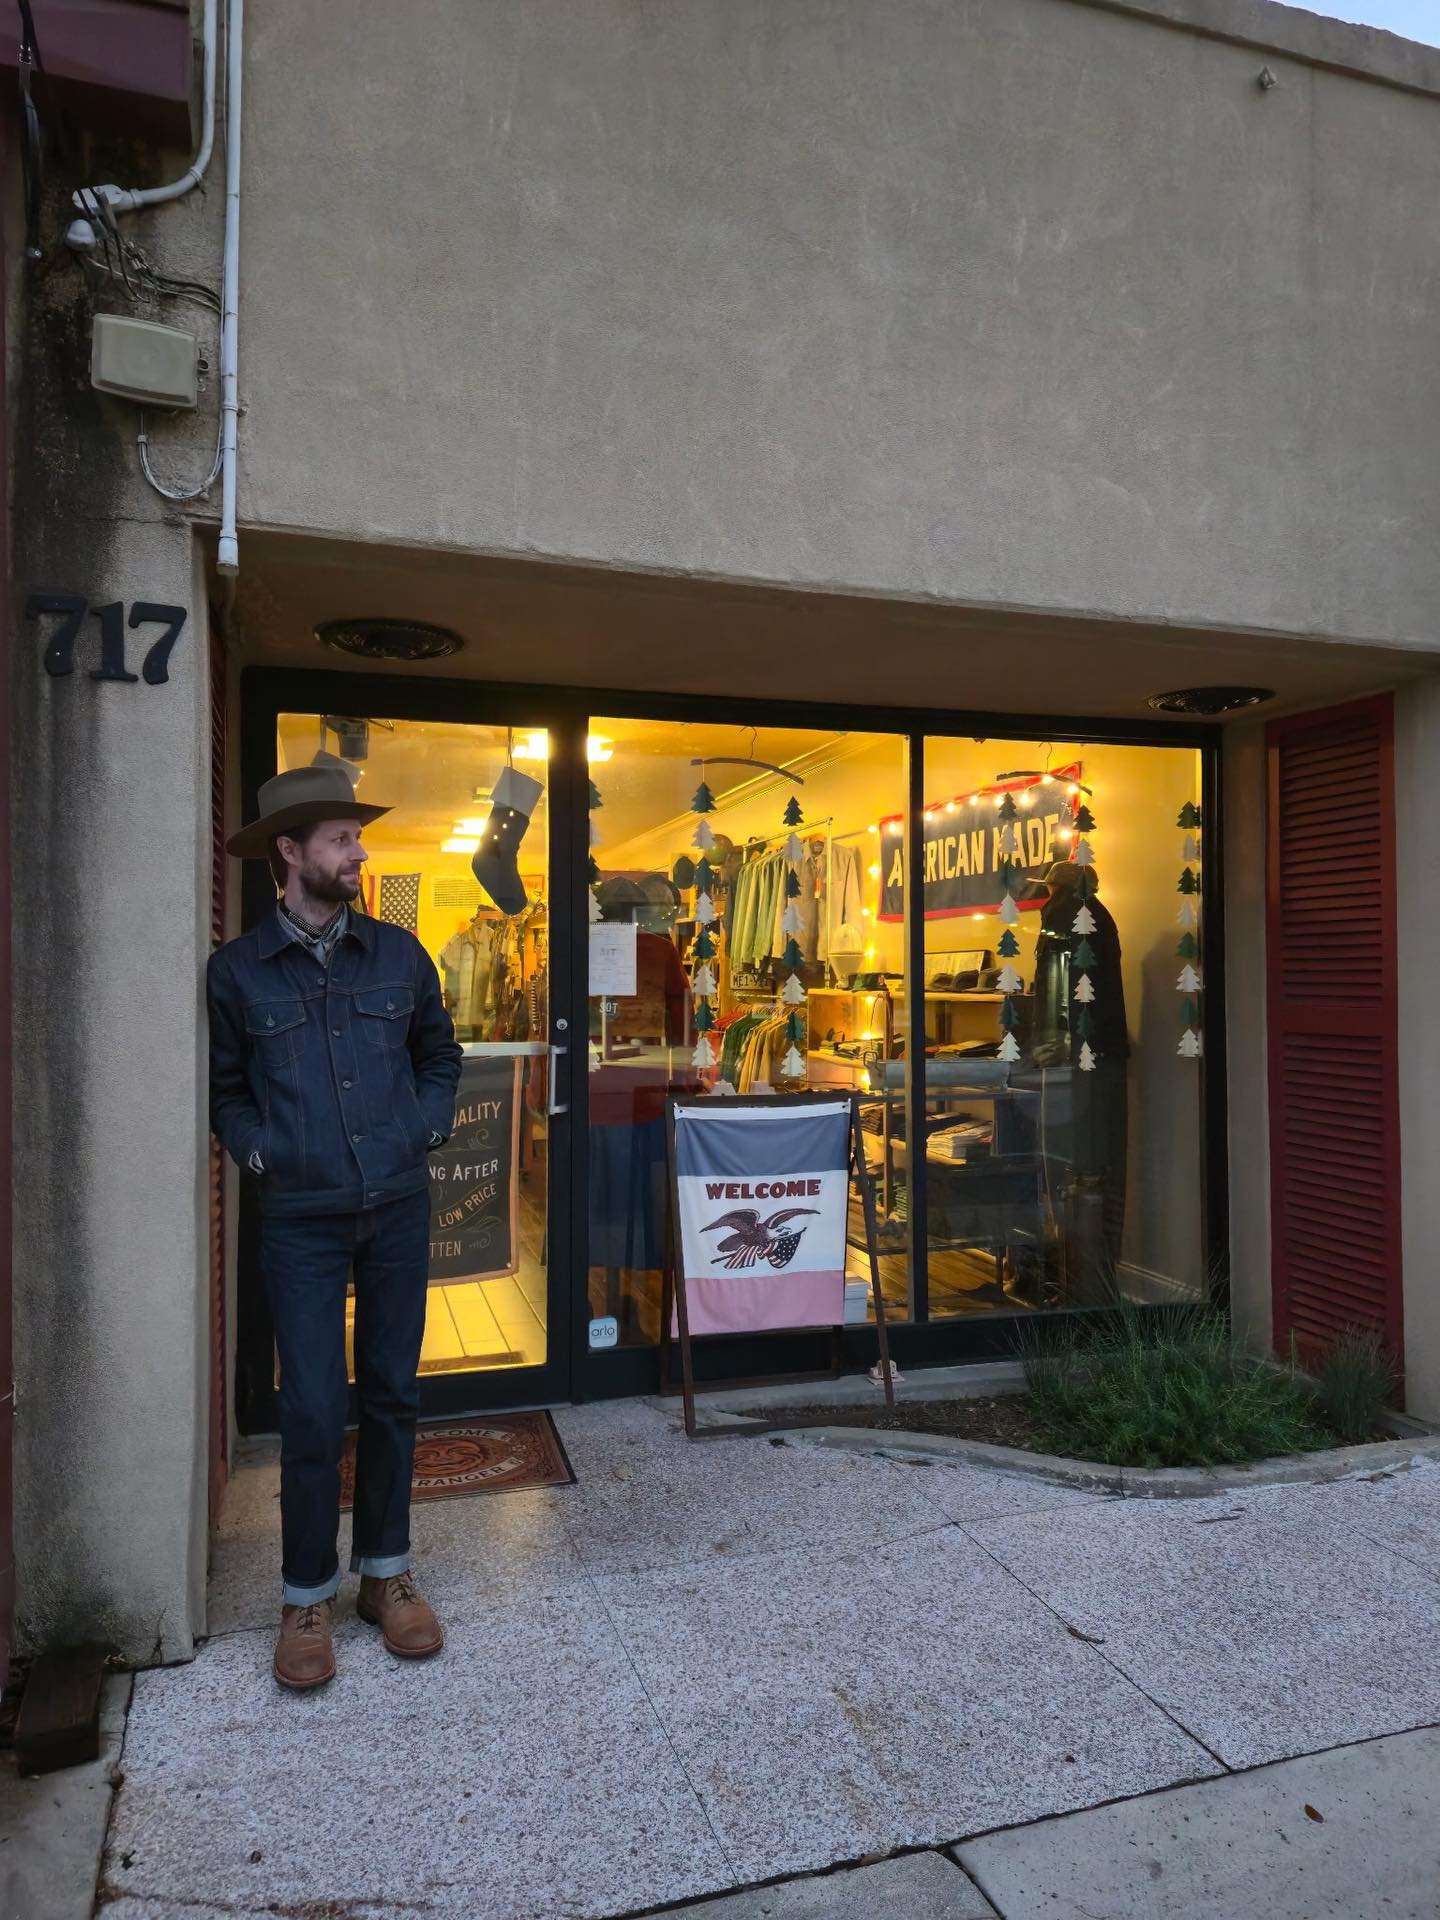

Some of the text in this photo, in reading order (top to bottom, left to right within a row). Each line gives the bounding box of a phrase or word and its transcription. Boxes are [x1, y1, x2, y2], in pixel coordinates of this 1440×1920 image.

[26, 592, 188, 685] 717
[887, 830, 985, 888] ARICAN
[452, 1101, 502, 1130] ALITY
[452, 1159, 499, 1182] AFTER
[705, 1179, 822, 1200] WELCOME
[438, 1183, 497, 1228] LOW PRICE
[415, 1466, 505, 1487] RANGER
